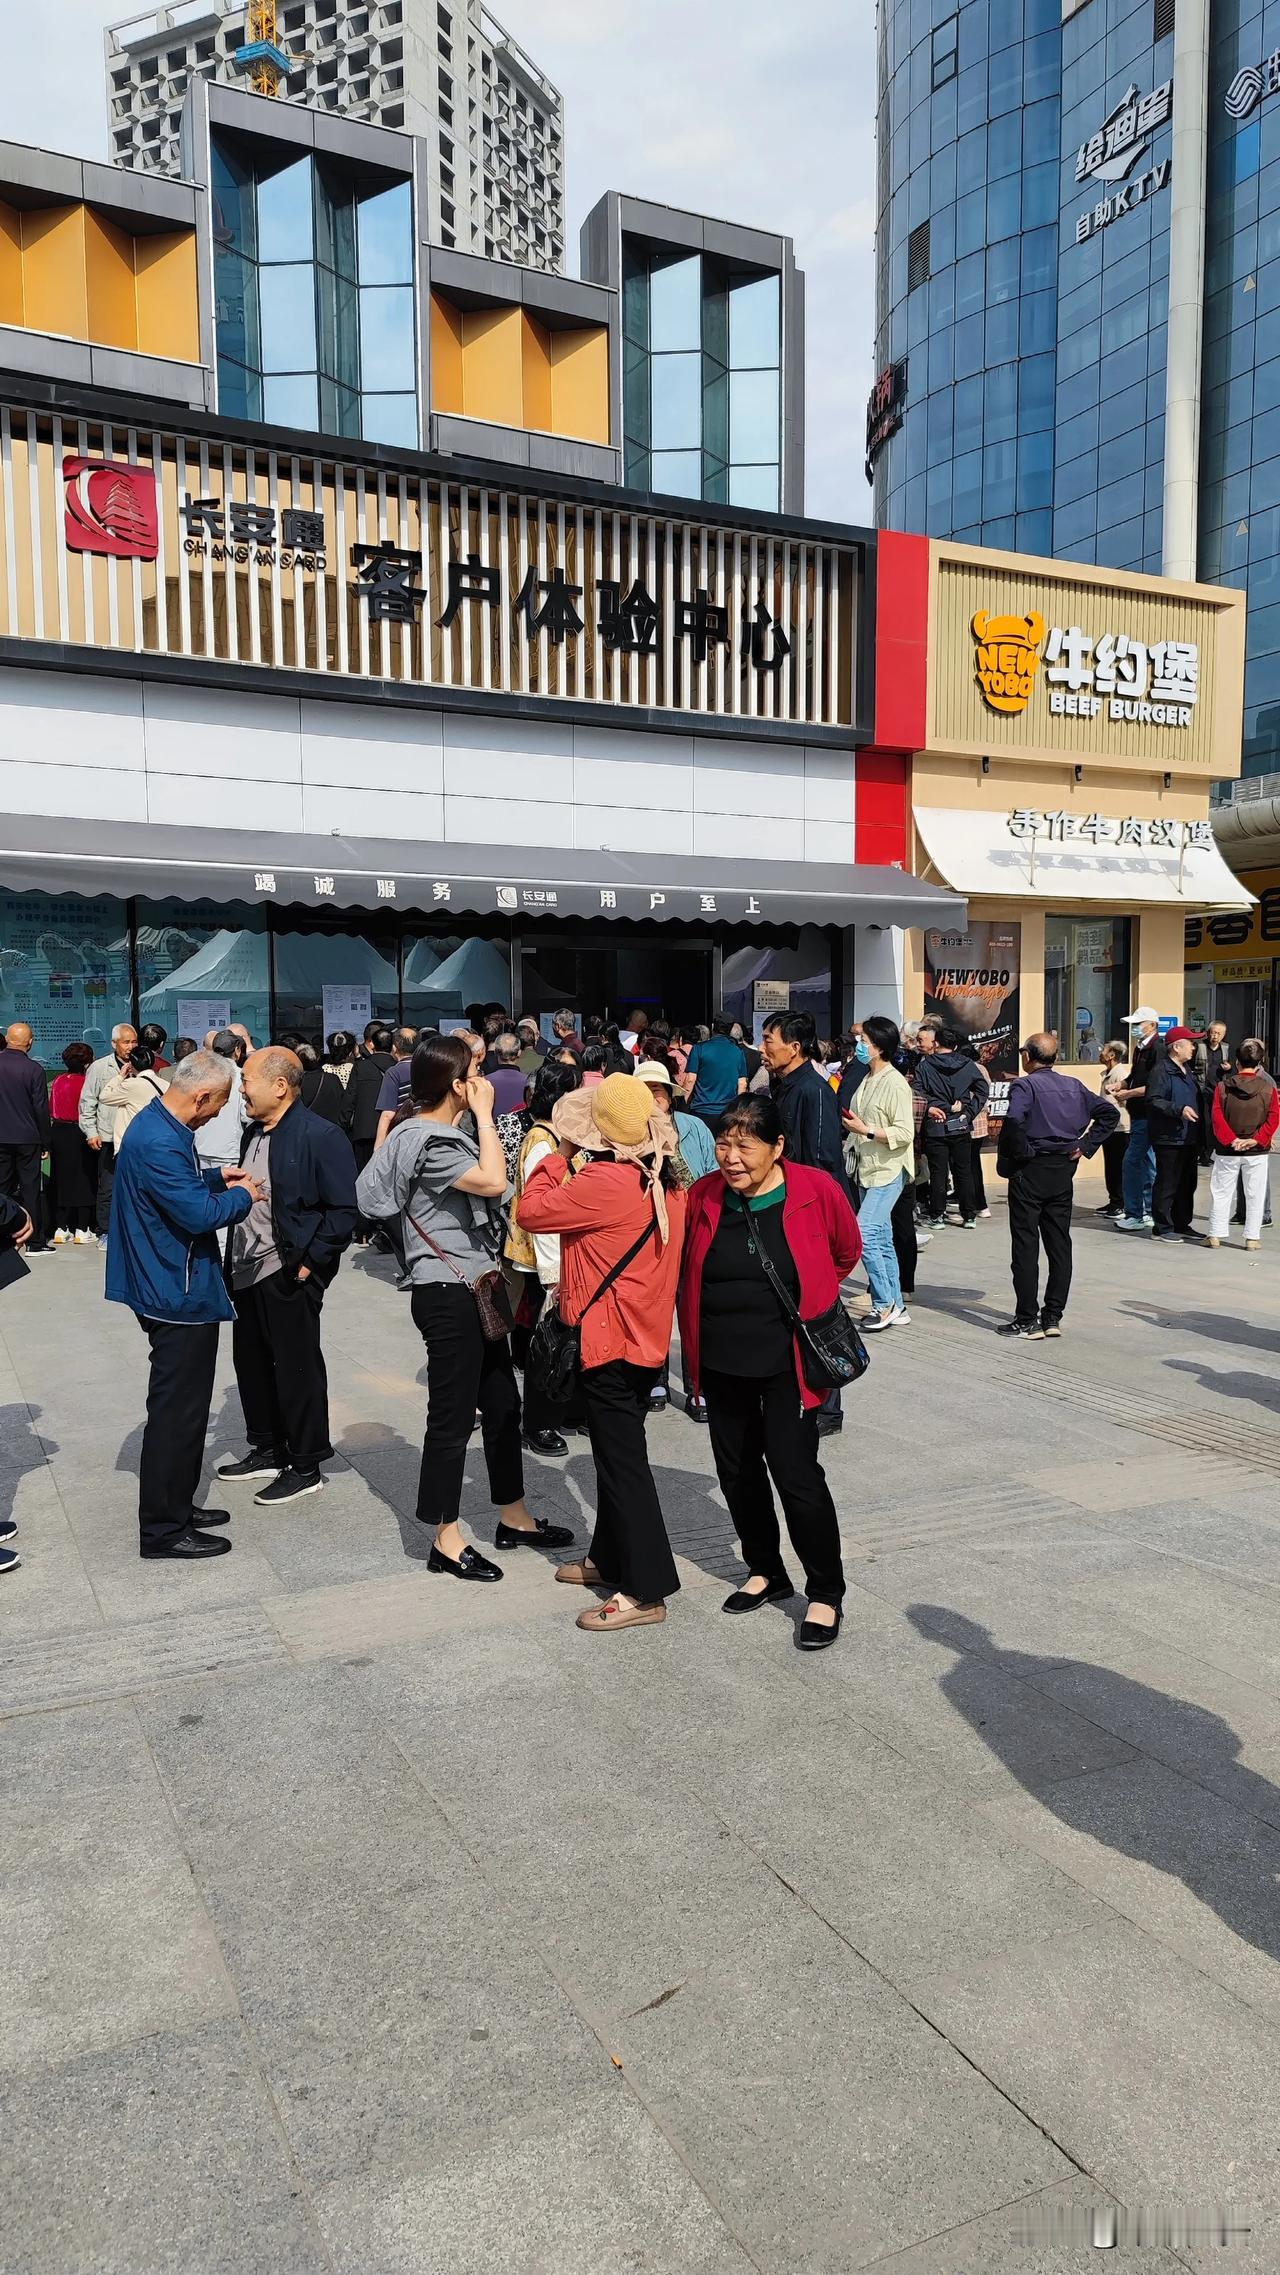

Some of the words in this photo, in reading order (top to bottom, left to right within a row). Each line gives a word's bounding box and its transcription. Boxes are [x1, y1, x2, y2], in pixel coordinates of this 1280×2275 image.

[1075, 158, 1170, 244] 自助KTV
[280, 552, 328, 572] CARD
[350, 540, 792, 671] 客户体验中心
[977, 643, 1041, 677] NEW
[1045, 626, 1199, 704] 牛约堡
[977, 670, 1034, 698] YOBO
[1050, 692, 1103, 717] BEEF
[1109, 699, 1192, 727] BURGER
[1008, 806, 1214, 852] 手作牛肉汉堡
[254, 872, 452, 901] 竭诚服务
[600, 889, 761, 914] 用户至上
